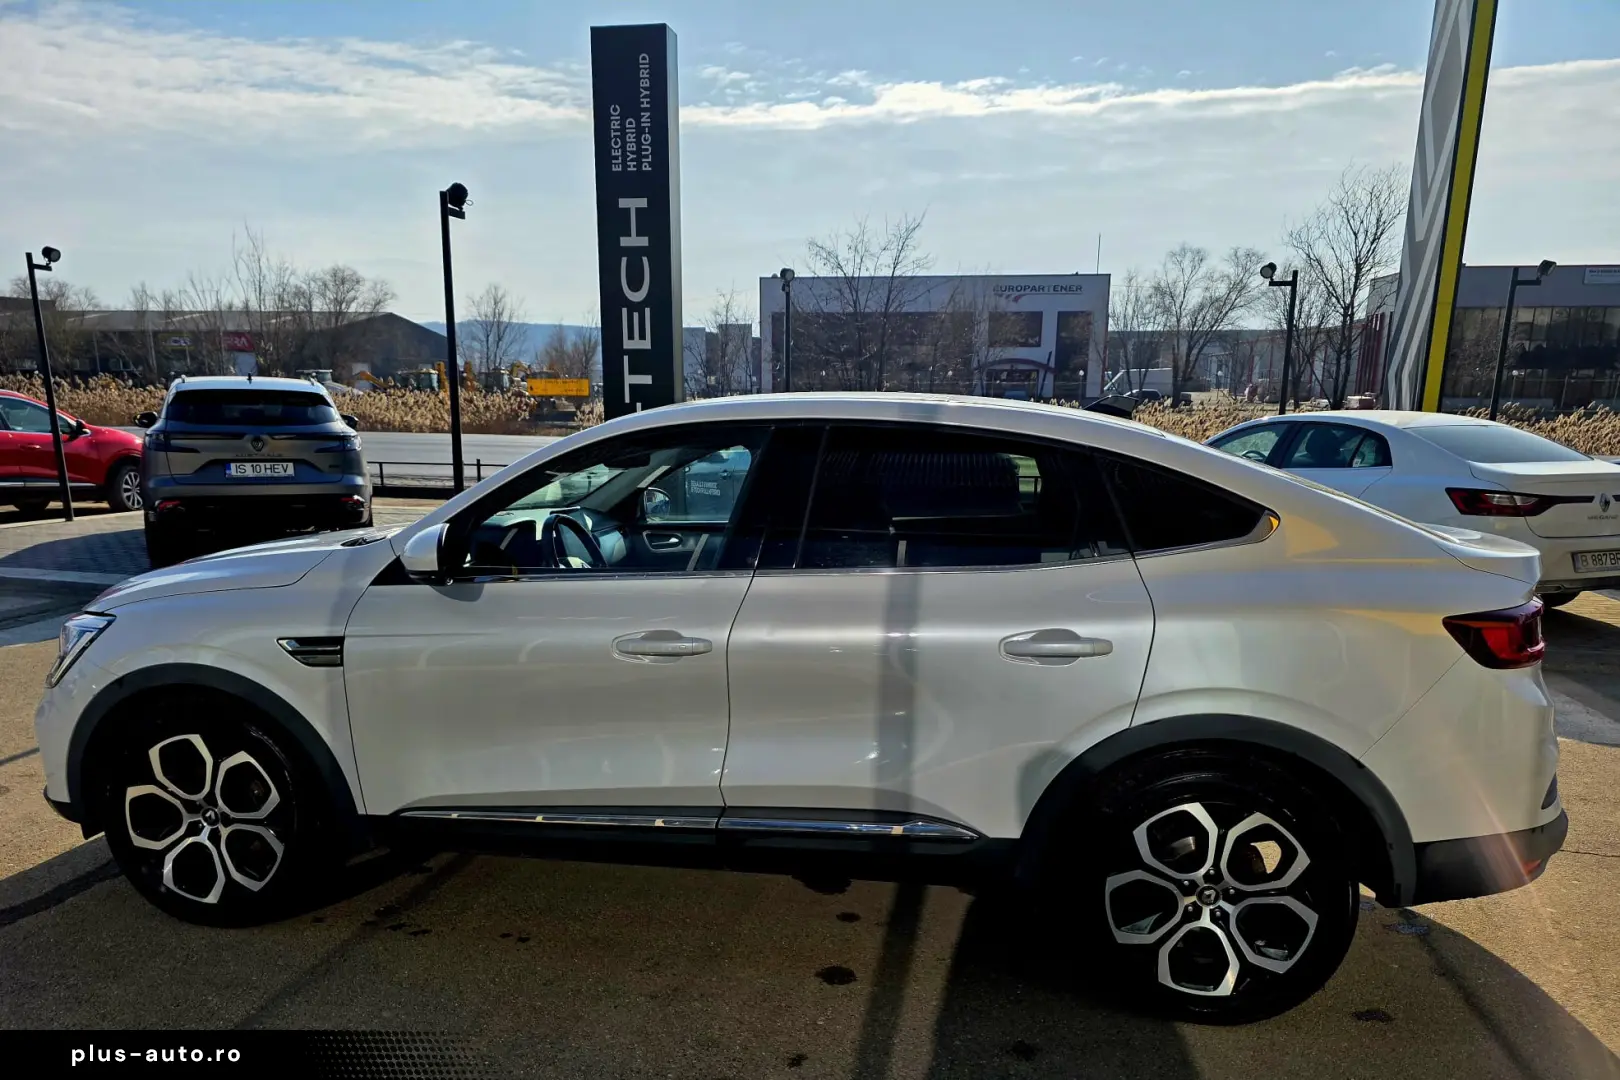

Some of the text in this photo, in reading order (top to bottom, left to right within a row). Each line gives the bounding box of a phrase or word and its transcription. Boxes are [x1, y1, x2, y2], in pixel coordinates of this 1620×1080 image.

[610, 104, 622, 171] ELECTRIC
[639, 53, 652, 171] PLUG-IN HYBRID
[626, 117, 637, 171] HYBRID
[235, 463, 289, 474] IS 10 HEV
[1580, 554, 1589, 567] B
